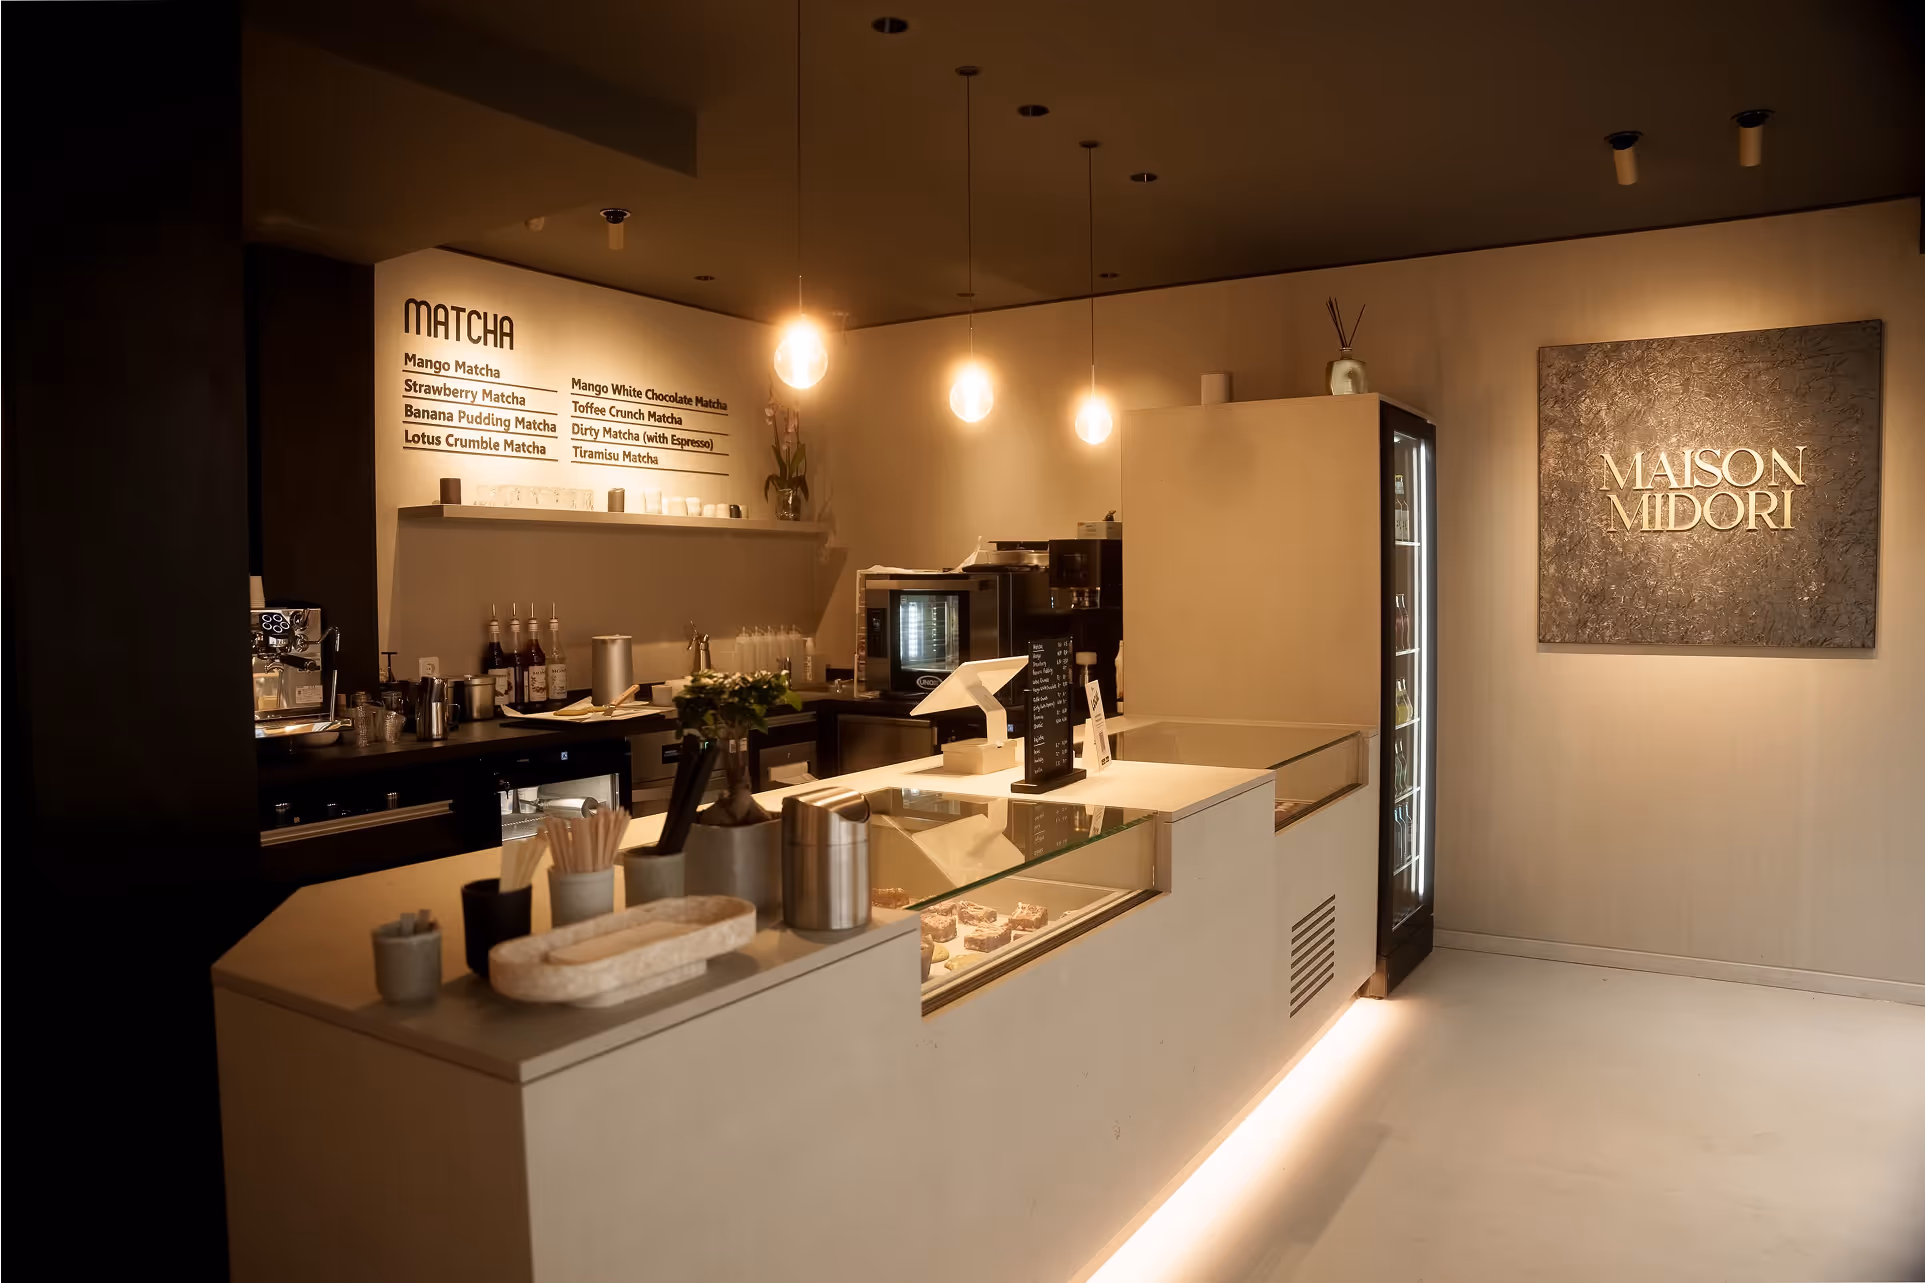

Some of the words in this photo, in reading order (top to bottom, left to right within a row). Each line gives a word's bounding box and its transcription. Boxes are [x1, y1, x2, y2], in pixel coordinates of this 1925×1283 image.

[404, 297, 514, 350] MATCHA
[404, 352, 450, 374] Mango
[454, 360, 500, 379] Matcha
[404, 378, 478, 403] Strawberry
[482, 388, 526, 406] Matcha
[571, 377, 608, 396] Mango
[611, 383, 643, 399] White
[645, 388, 693, 406] Chocolate
[695, 395, 728, 411] Matcha
[404, 403, 454, 422] Banana
[458, 409, 511, 432] Pudding
[514, 416, 557, 433] Matcha
[572, 400, 606, 416] Toffee
[608, 405, 645, 421] Crunch
[647, 410, 683, 425] Matcha
[404, 429, 442, 446] Lotus
[445, 433, 500, 451] Crumble
[503, 438, 547, 455] Matcha
[571, 422, 600, 440] Dirty
[602, 426, 640, 442] Matcha
[643, 430, 669, 445] (with
[671, 434, 714, 451] Espresso)
[572, 445, 619, 462] Tiramisu
[622, 450, 659, 465] Matcha
[1599, 446, 1807, 491] MAISON
[1606, 489, 1795, 532] MIDORI
